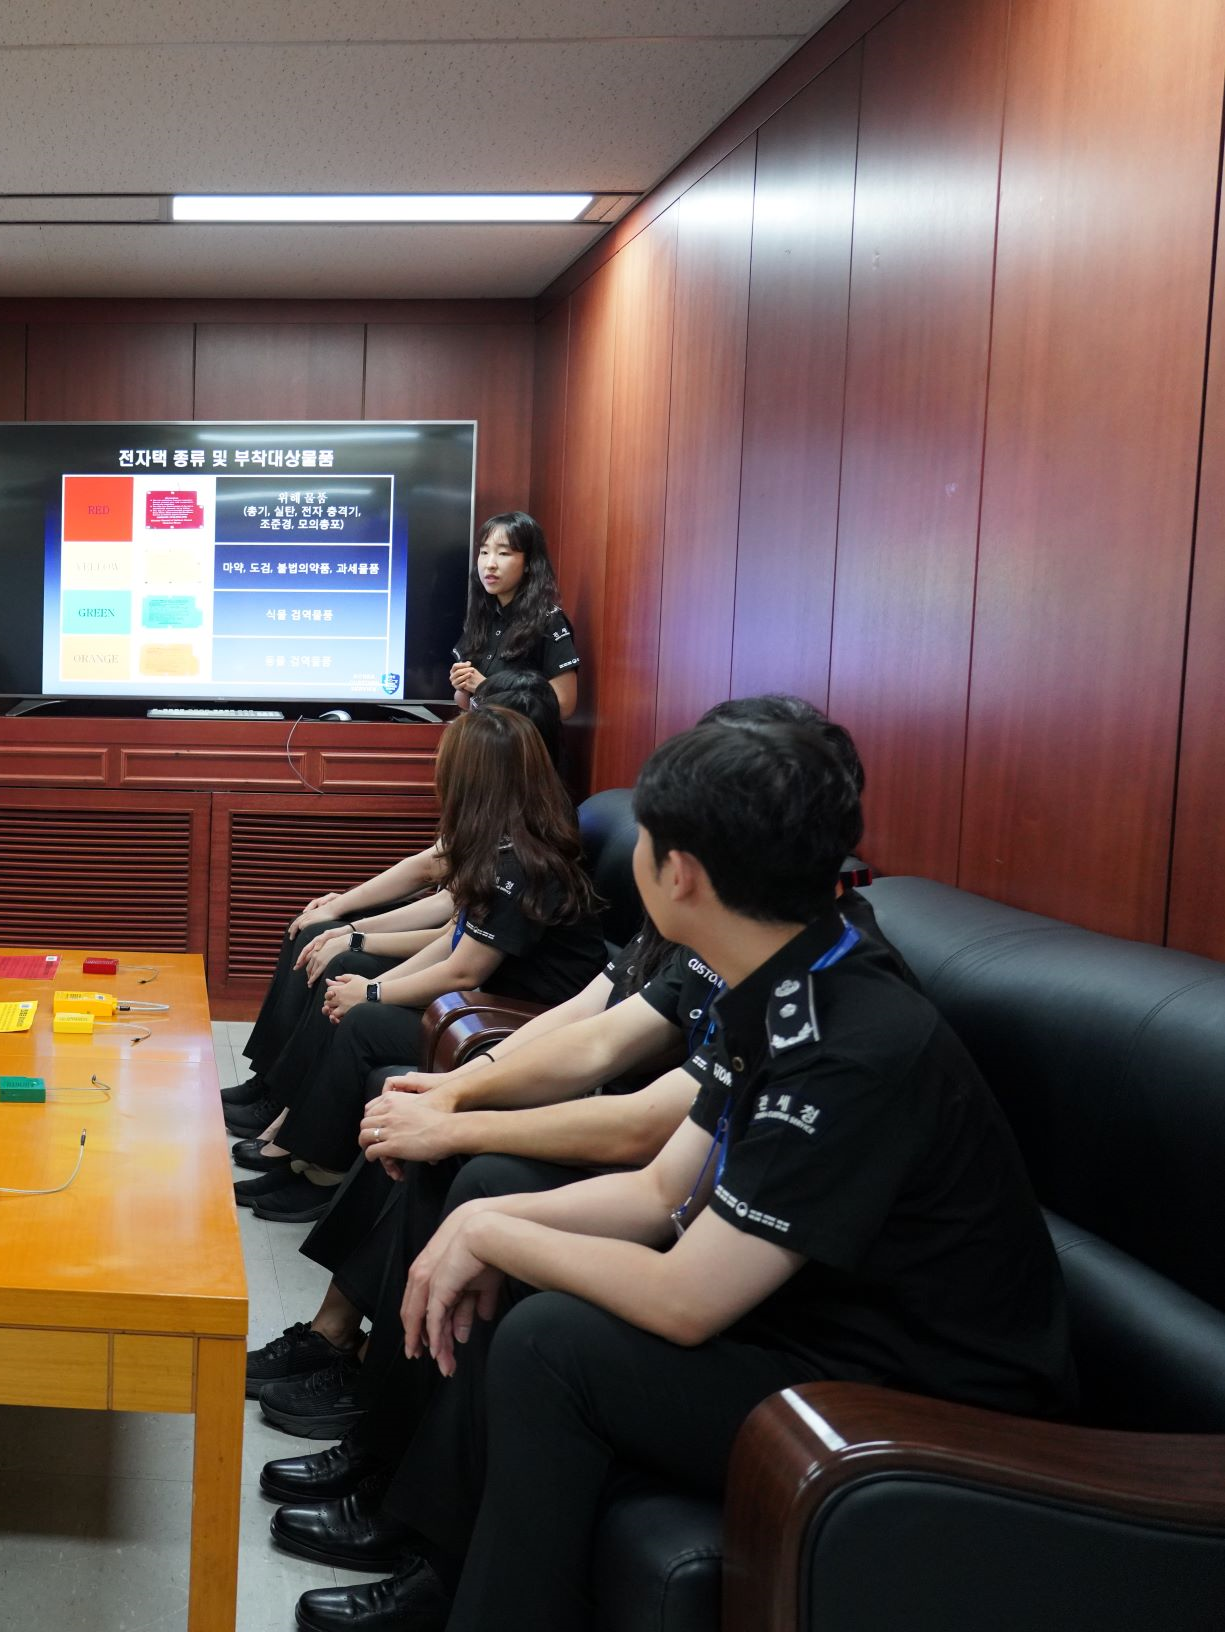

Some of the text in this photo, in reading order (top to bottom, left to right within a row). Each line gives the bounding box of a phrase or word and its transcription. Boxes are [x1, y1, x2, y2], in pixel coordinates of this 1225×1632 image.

[118, 449, 334, 467] 전자택 종류 및 부착대상물품
[87, 505, 110, 515] RED
[301, 506, 323, 517] 전자
[222, 562, 247, 574] 마약,
[336, 563, 380, 575] 과세물품
[78, 608, 116, 618] GREEN
[265, 609, 334, 622] 식물 검역물품
[73, 654, 119, 664] ORANGE
